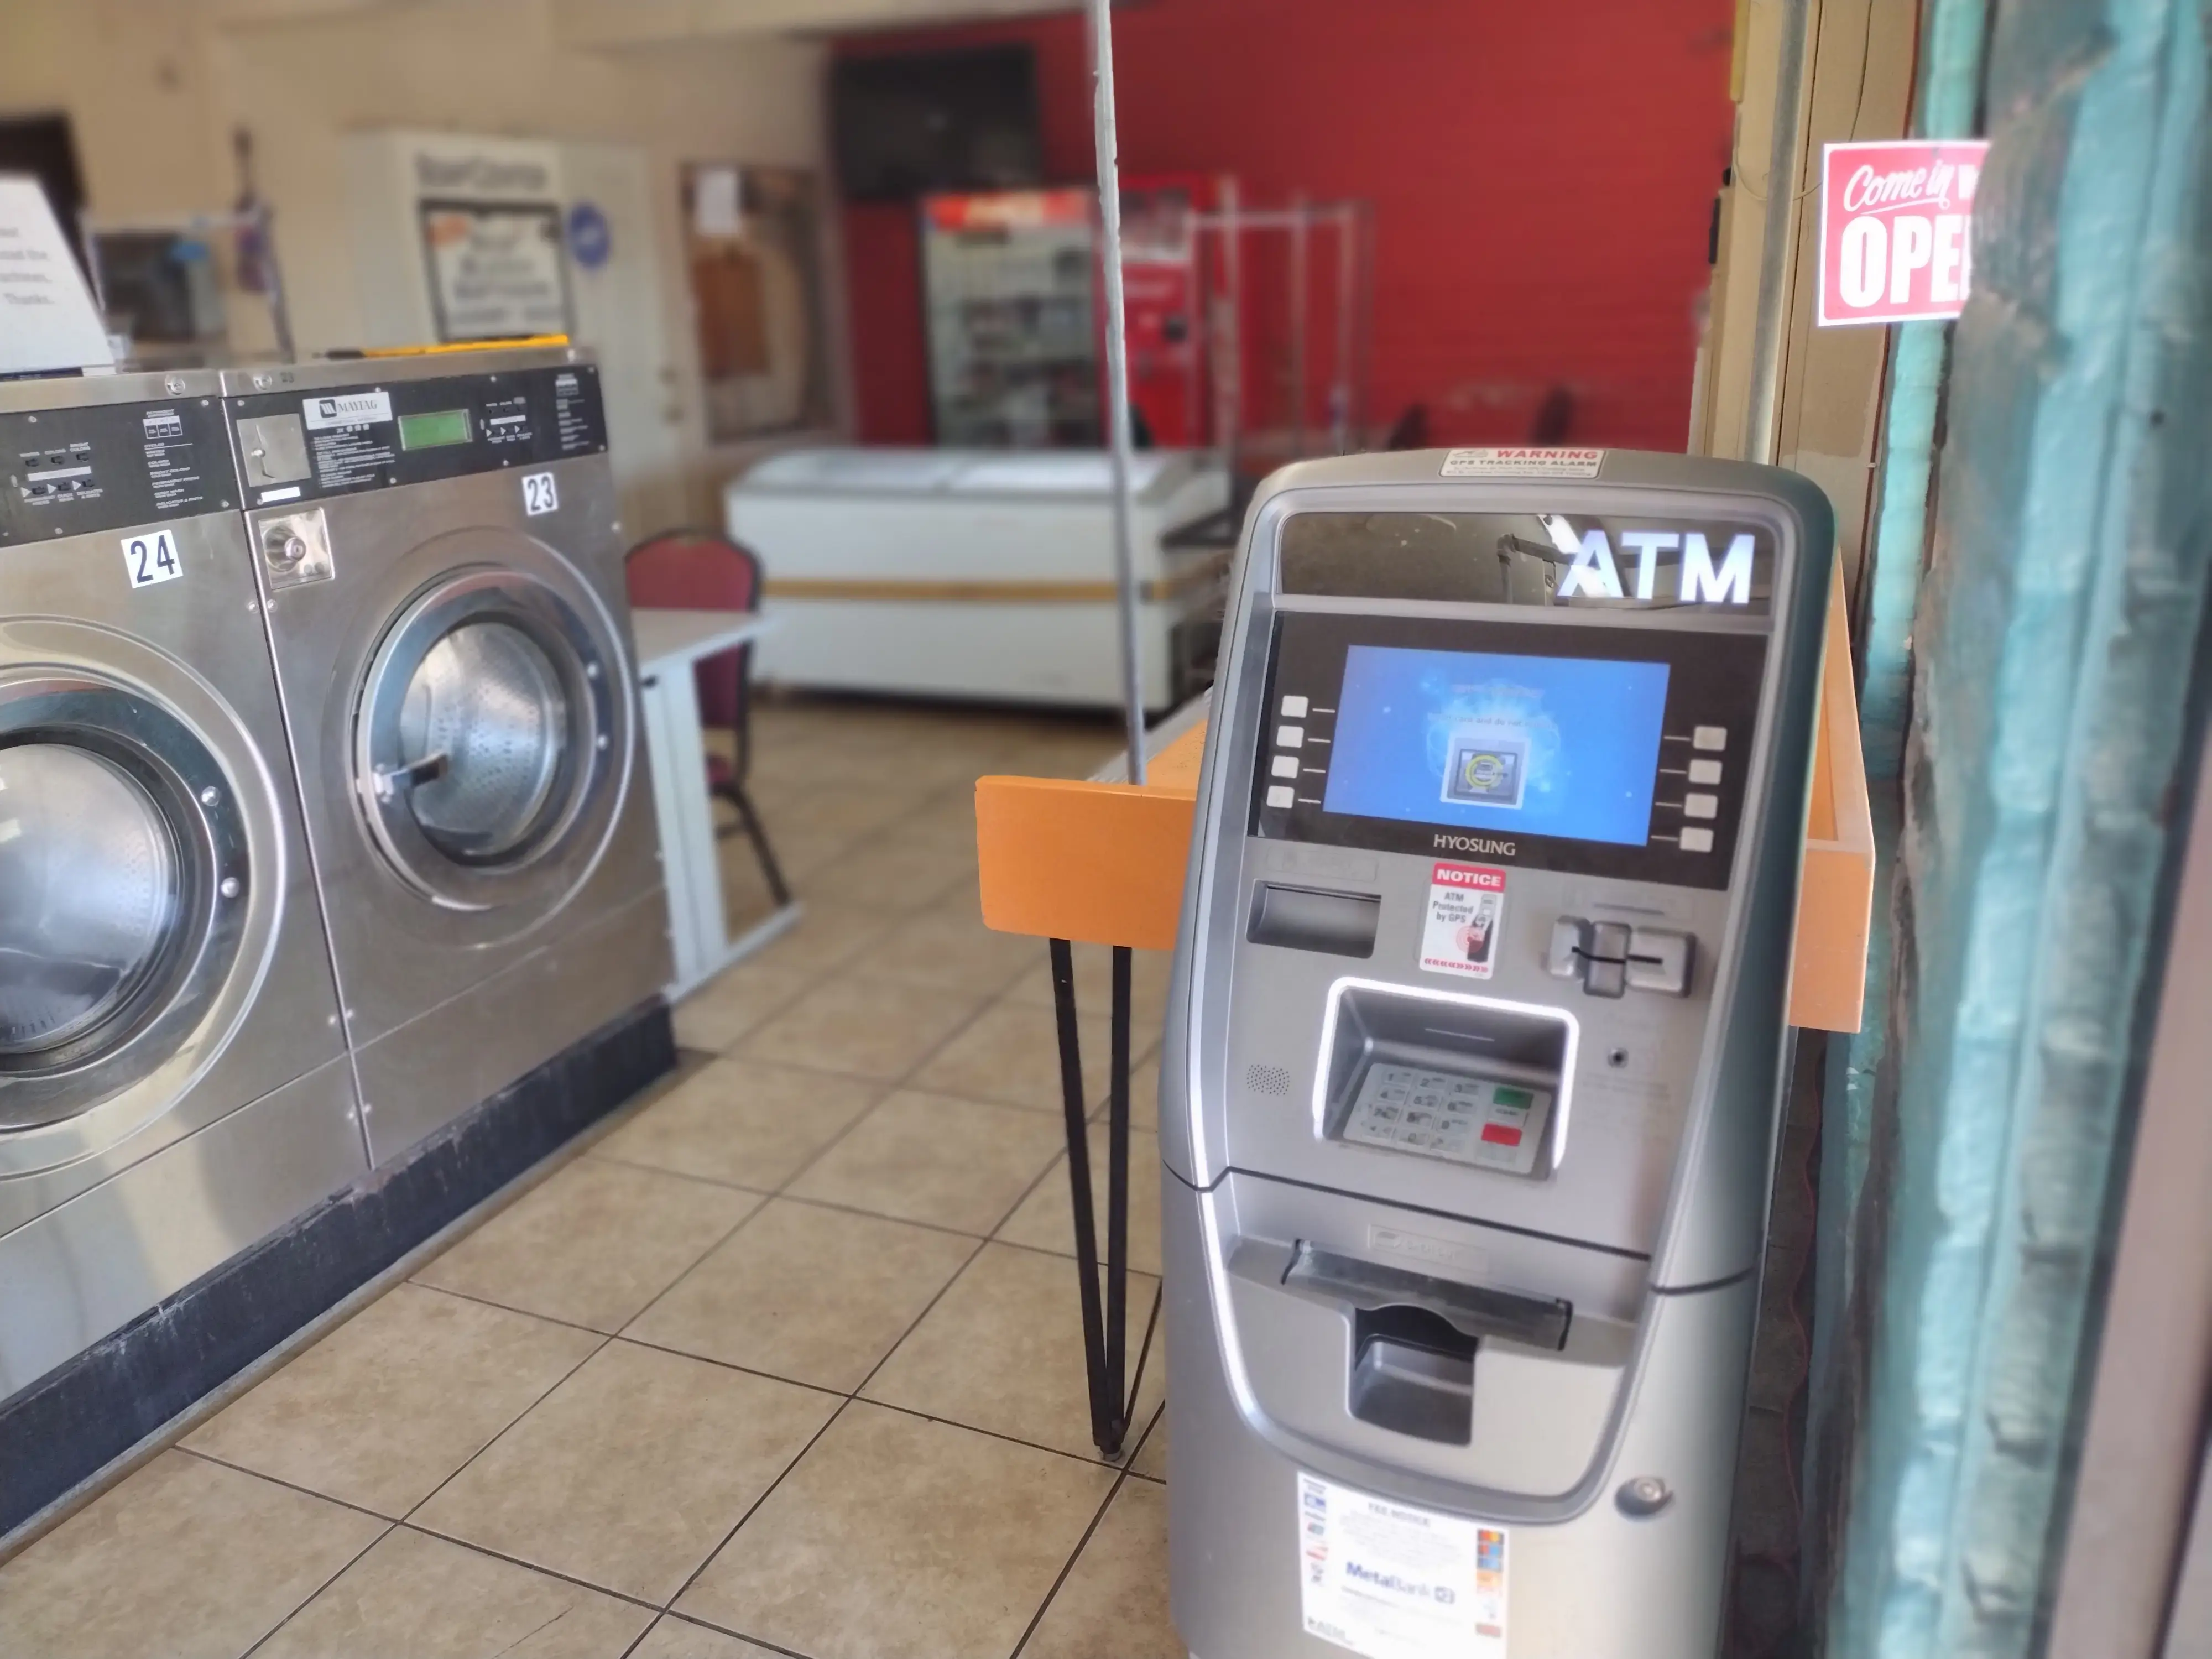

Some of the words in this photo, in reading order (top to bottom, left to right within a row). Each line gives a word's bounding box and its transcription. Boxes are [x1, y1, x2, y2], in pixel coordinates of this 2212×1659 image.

[1843, 164, 1927, 212] Come
[1926, 159, 1955, 198] in
[338, 400, 377, 413] MAYTAG
[1497, 450, 1598, 460] WARNING
[527, 476, 555, 512] 23
[130, 535, 175, 583] 24
[1557, 529, 1755, 604] ATM
[1433, 834, 1516, 856] HYOSUNG
[1437, 869, 1502, 887] NOTICE
[1444, 892, 1464, 901] ATM
[1432, 901, 1474, 914] Protected
[1436, 911, 1446, 922] by
[1448, 914, 1467, 923] GPS
